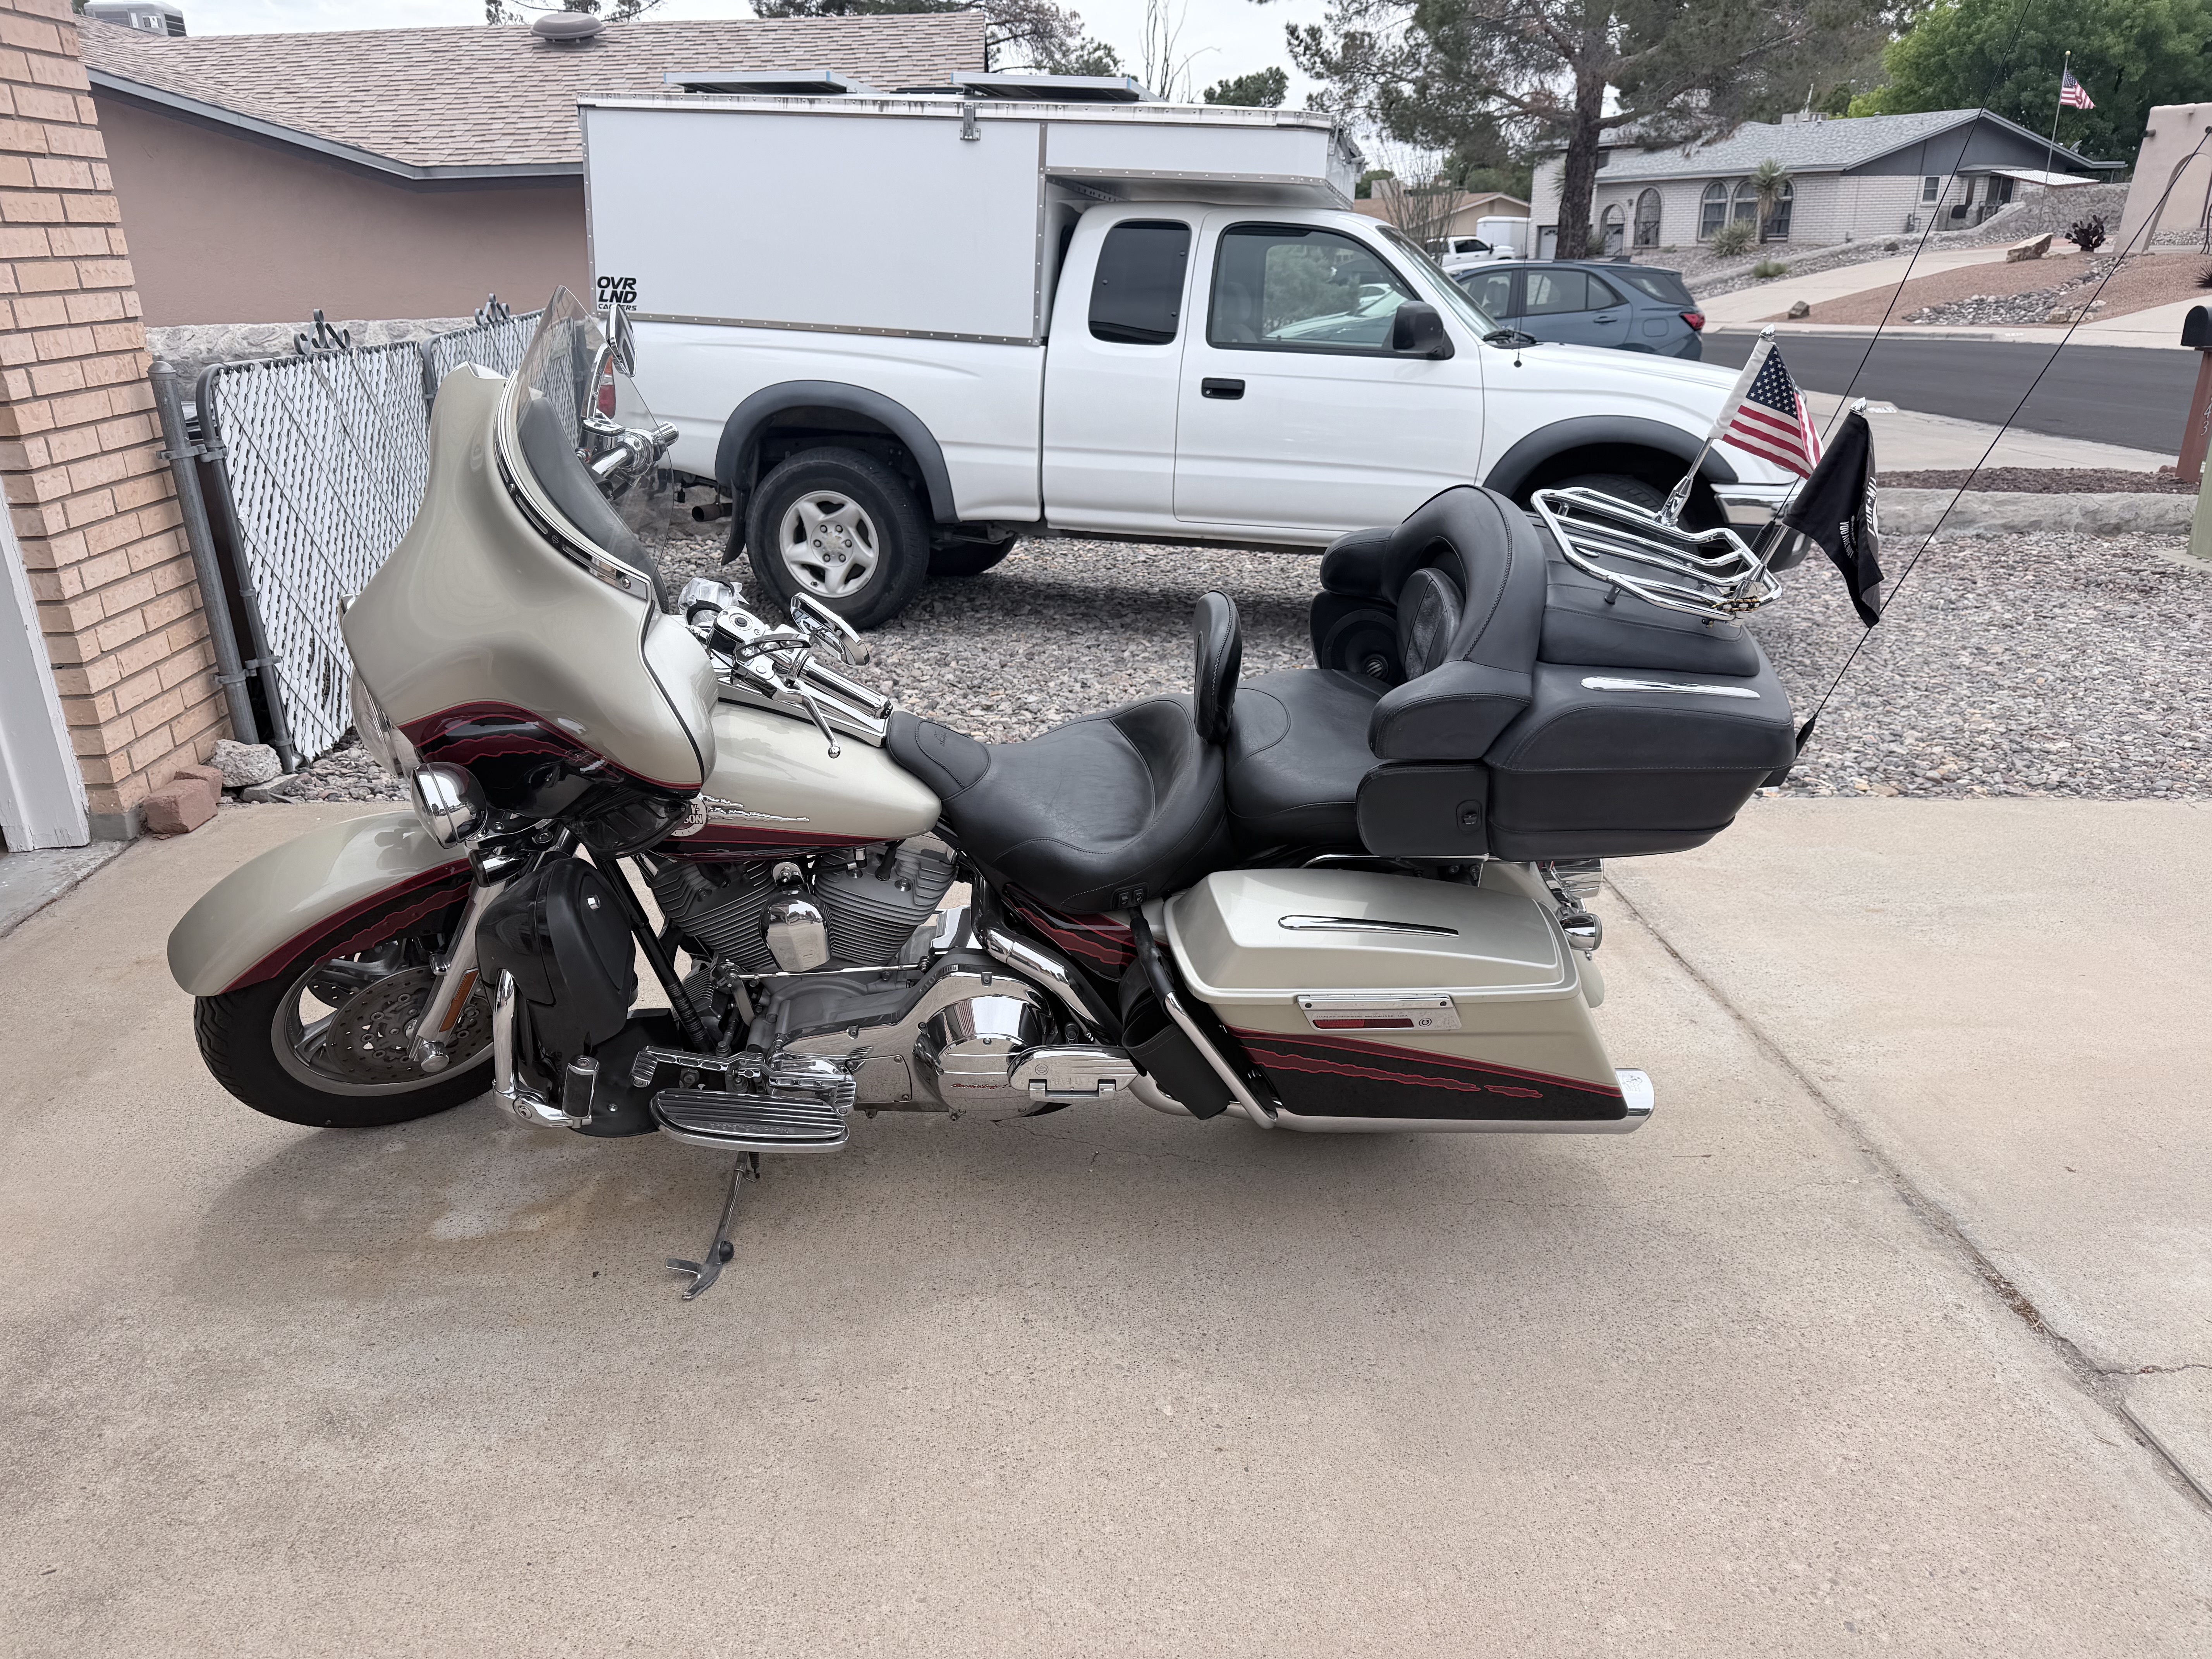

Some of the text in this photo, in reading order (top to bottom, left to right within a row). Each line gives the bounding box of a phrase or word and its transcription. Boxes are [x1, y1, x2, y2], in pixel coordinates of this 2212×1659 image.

[597, 276, 636, 290] OVR
[598, 290, 637, 303] LND
[1839, 521, 1849, 535] YOU
